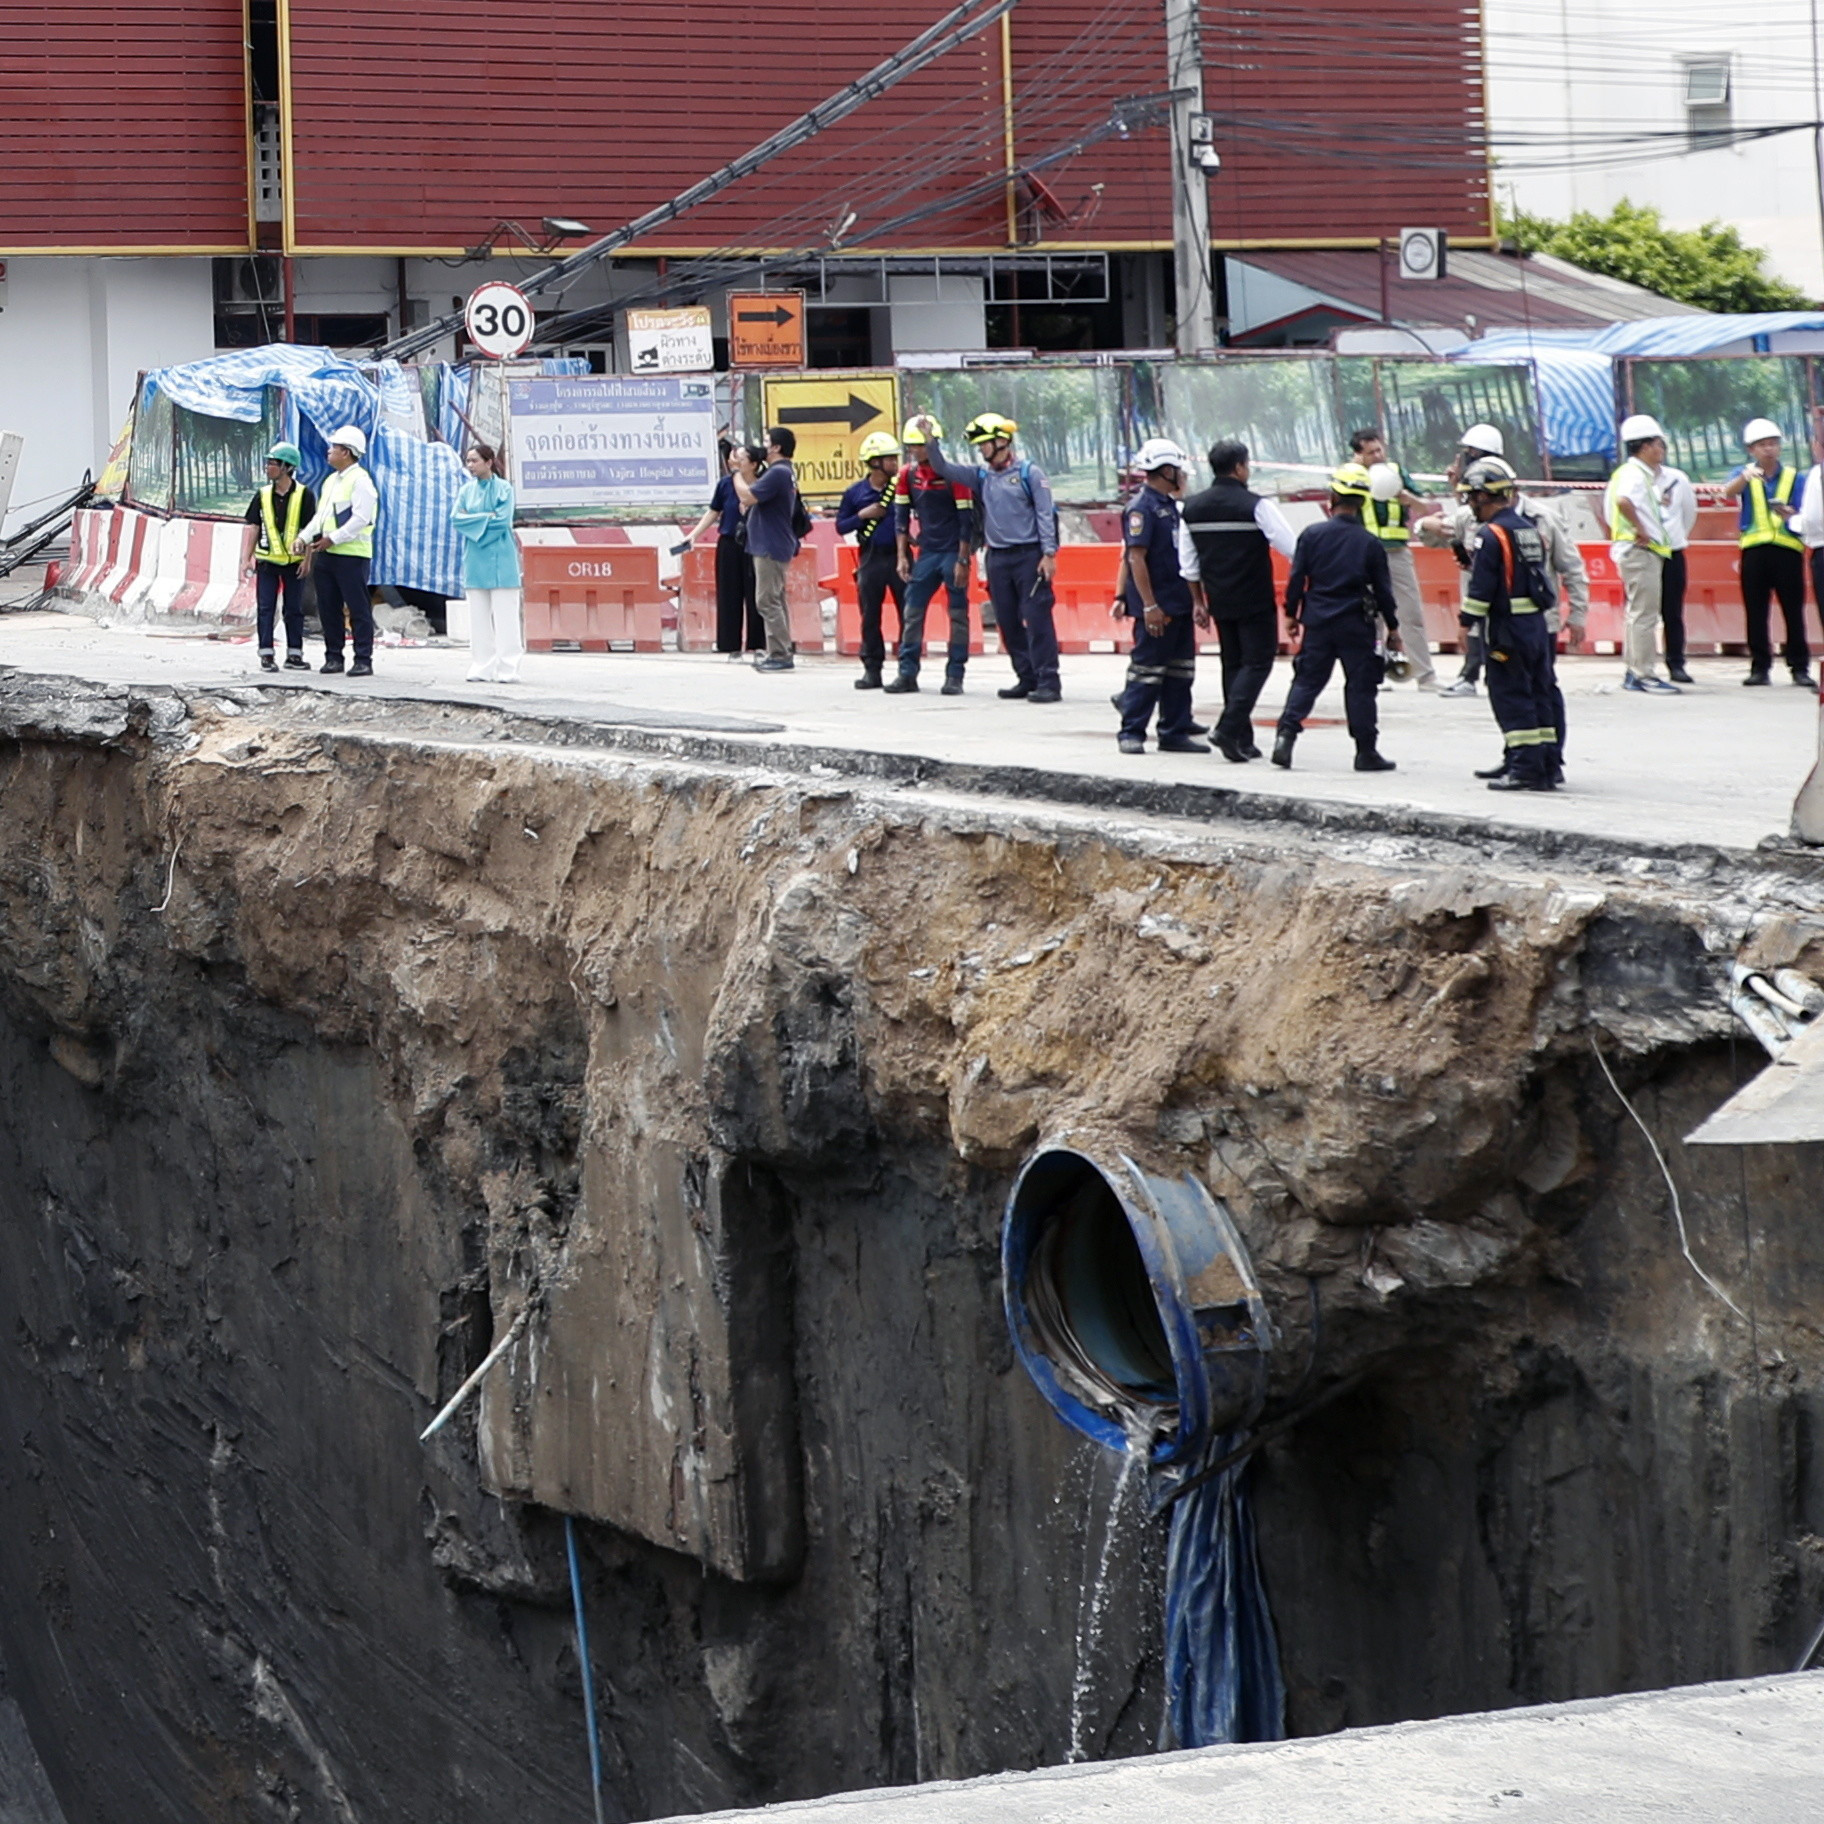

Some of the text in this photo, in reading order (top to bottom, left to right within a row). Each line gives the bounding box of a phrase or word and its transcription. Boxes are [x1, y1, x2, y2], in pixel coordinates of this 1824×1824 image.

[474, 304, 526, 337] 30
[660, 333, 697, 349] ผิวทาง
[661, 348, 712, 366] ต่างระดับ
[525, 416, 702, 460] จุดก่อสร้างทางขึ้นลง
[608, 463, 706, 481] Vajira Hospital Station
[568, 562, 612, 577] OR18
